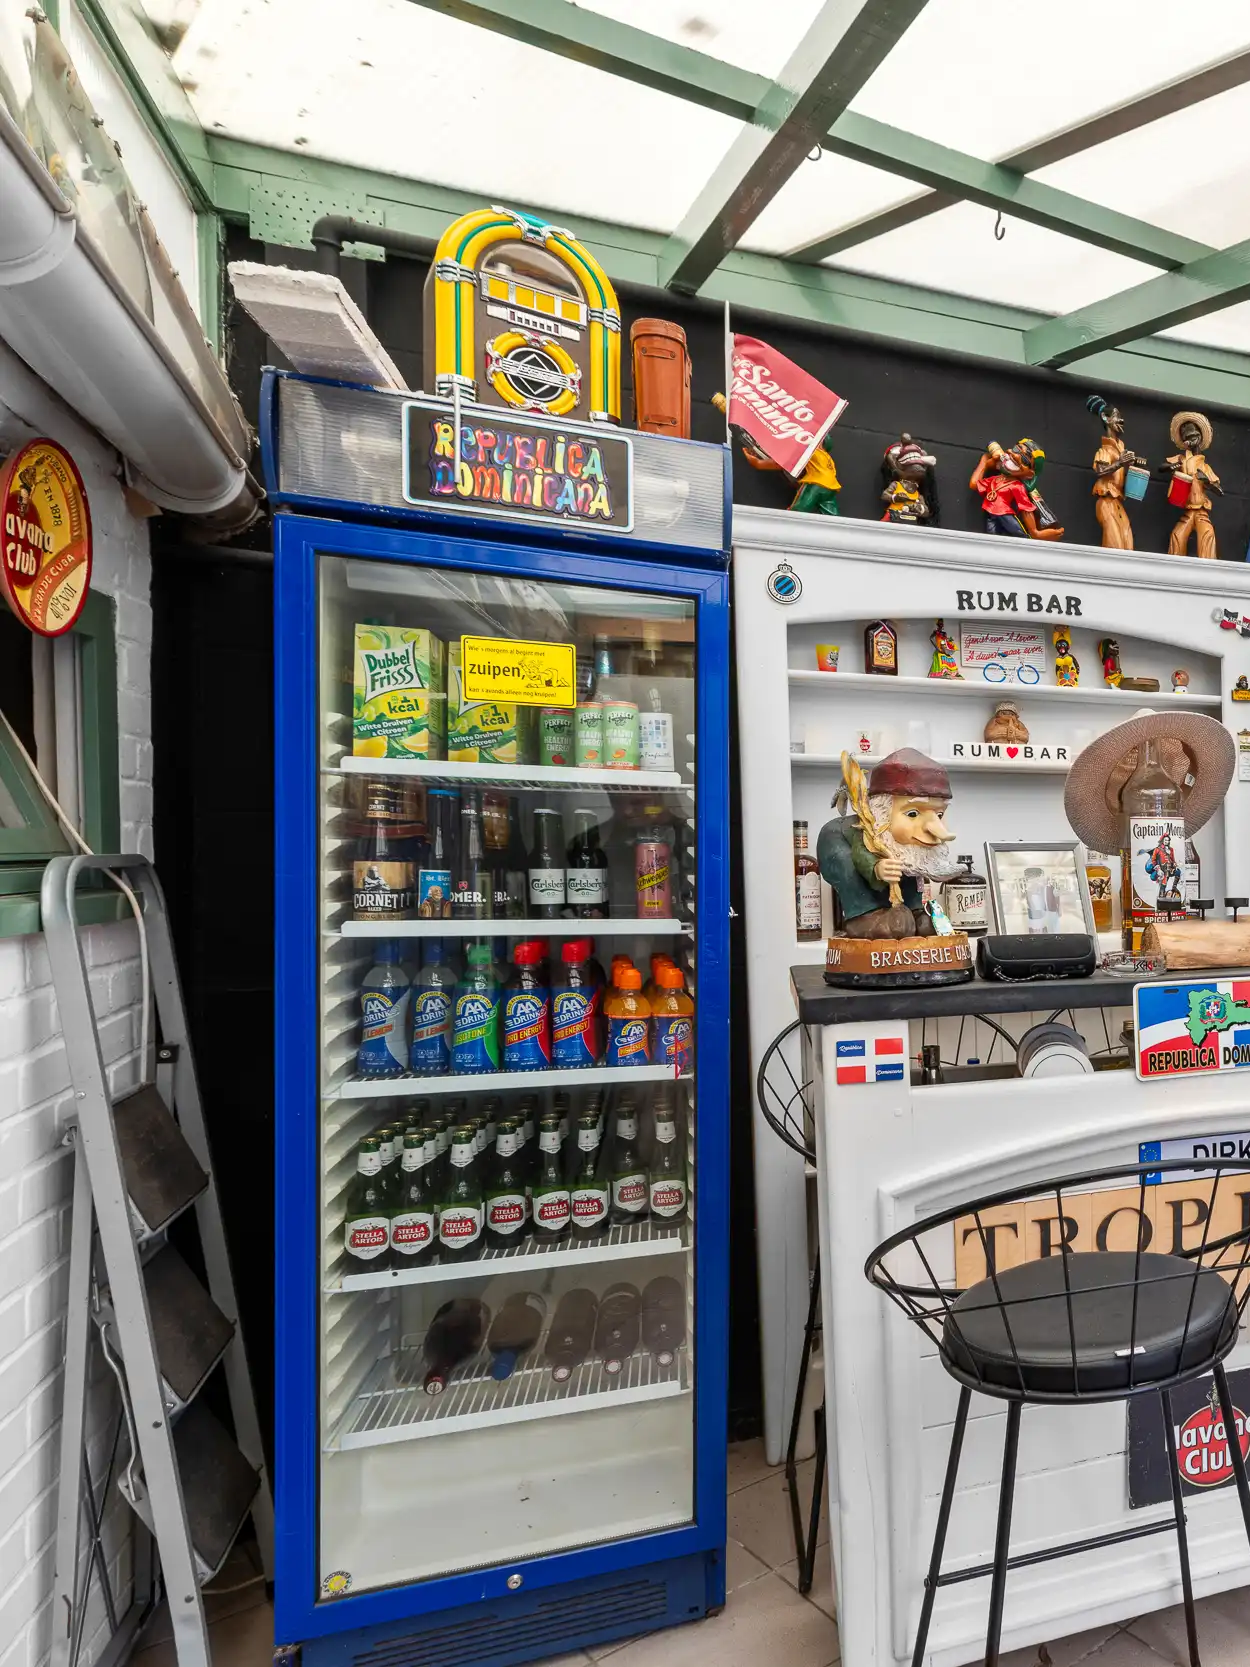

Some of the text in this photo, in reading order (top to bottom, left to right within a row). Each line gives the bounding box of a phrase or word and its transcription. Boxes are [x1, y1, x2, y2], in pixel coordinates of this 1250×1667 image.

[738, 365, 816, 422] Santo
[6, 512, 54, 554] avana
[6, 542, 37, 576] Club
[50, 554, 76, 577] CUBA
[956, 590, 1082, 616] RUM BAR
[365, 649, 411, 673] Dubbel
[469, 661, 525, 680] zuipen,
[387, 699, 420, 715] kcal
[480, 711, 510, 727] kcal
[579, 711, 603, 721] PERFEC
[358, 717, 414, 732] Witte Druiven
[452, 731, 503, 744] Witte Druiven
[954, 744, 1067, 760] RUM BAR
[1133, 823, 1164, 840] Captain
[531, 878, 565, 893] Carlsber
[354, 893, 399, 910] CORNET
[871, 947, 952, 968] BRASSERIE
[366, 1000, 383, 1014] AA
[426, 999, 445, 1014] AA
[465, 1002, 487, 1017] AA
[516, 1002, 537, 1017] AA
[562, 999, 582, 1014] AA
[461, 1011, 491, 1024] DRINK
[513, 1011, 540, 1026] DRINK
[560, 1010, 587, 1023] DRINK
[507, 1025, 543, 1043] PRO ENERGY
[554, 1021, 589, 1040] PRO ENERGY
[630, 1024, 645, 1035] AA
[1148, 1047, 1216, 1072] REPUBLICA
[623, 1186, 645, 1195] STELLA
[623, 1191, 645, 1200] ARTOIS
[656, 1192, 680, 1200] STELLA
[543, 1201, 567, 1212] STELLA
[574, 1200, 598, 1208] STELLA
[656, 1196, 680, 1205] ARTOIS
[543, 1207, 568, 1217] ARTOIS
[574, 1206, 599, 1214] ARTOIS
[397, 1227, 425, 1235] STELLA
[445, 1221, 472, 1229] STELLA
[355, 1231, 383, 1239] STELLA
[397, 1232, 426, 1240] ARTOIS
